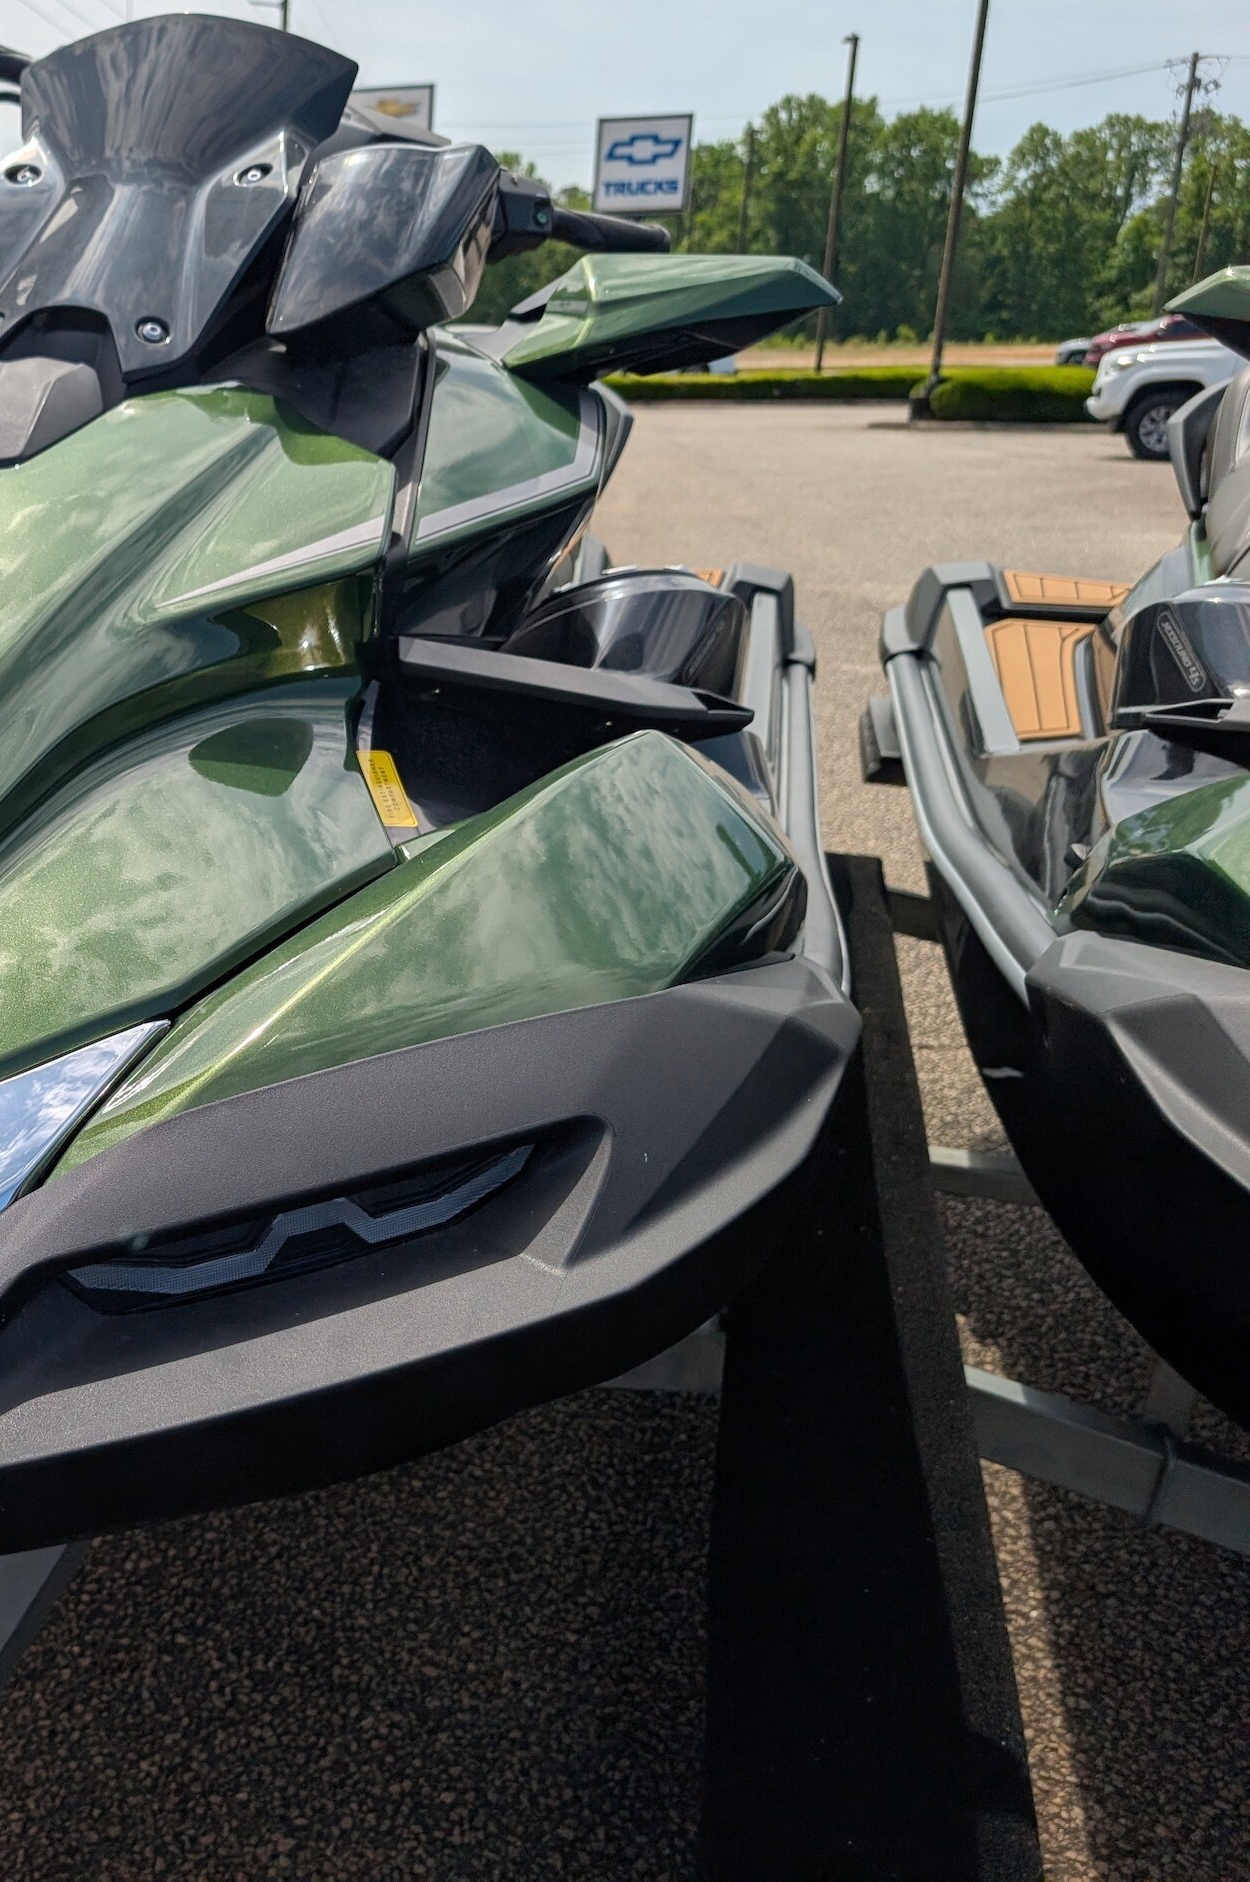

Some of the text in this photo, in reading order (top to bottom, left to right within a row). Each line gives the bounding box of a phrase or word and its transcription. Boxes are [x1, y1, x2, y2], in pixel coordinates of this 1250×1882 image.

[604, 180, 679, 197] TRUCKS
[378, 766, 400, 811] COMPARTMENT
[385, 805, 395, 819] FIRE
